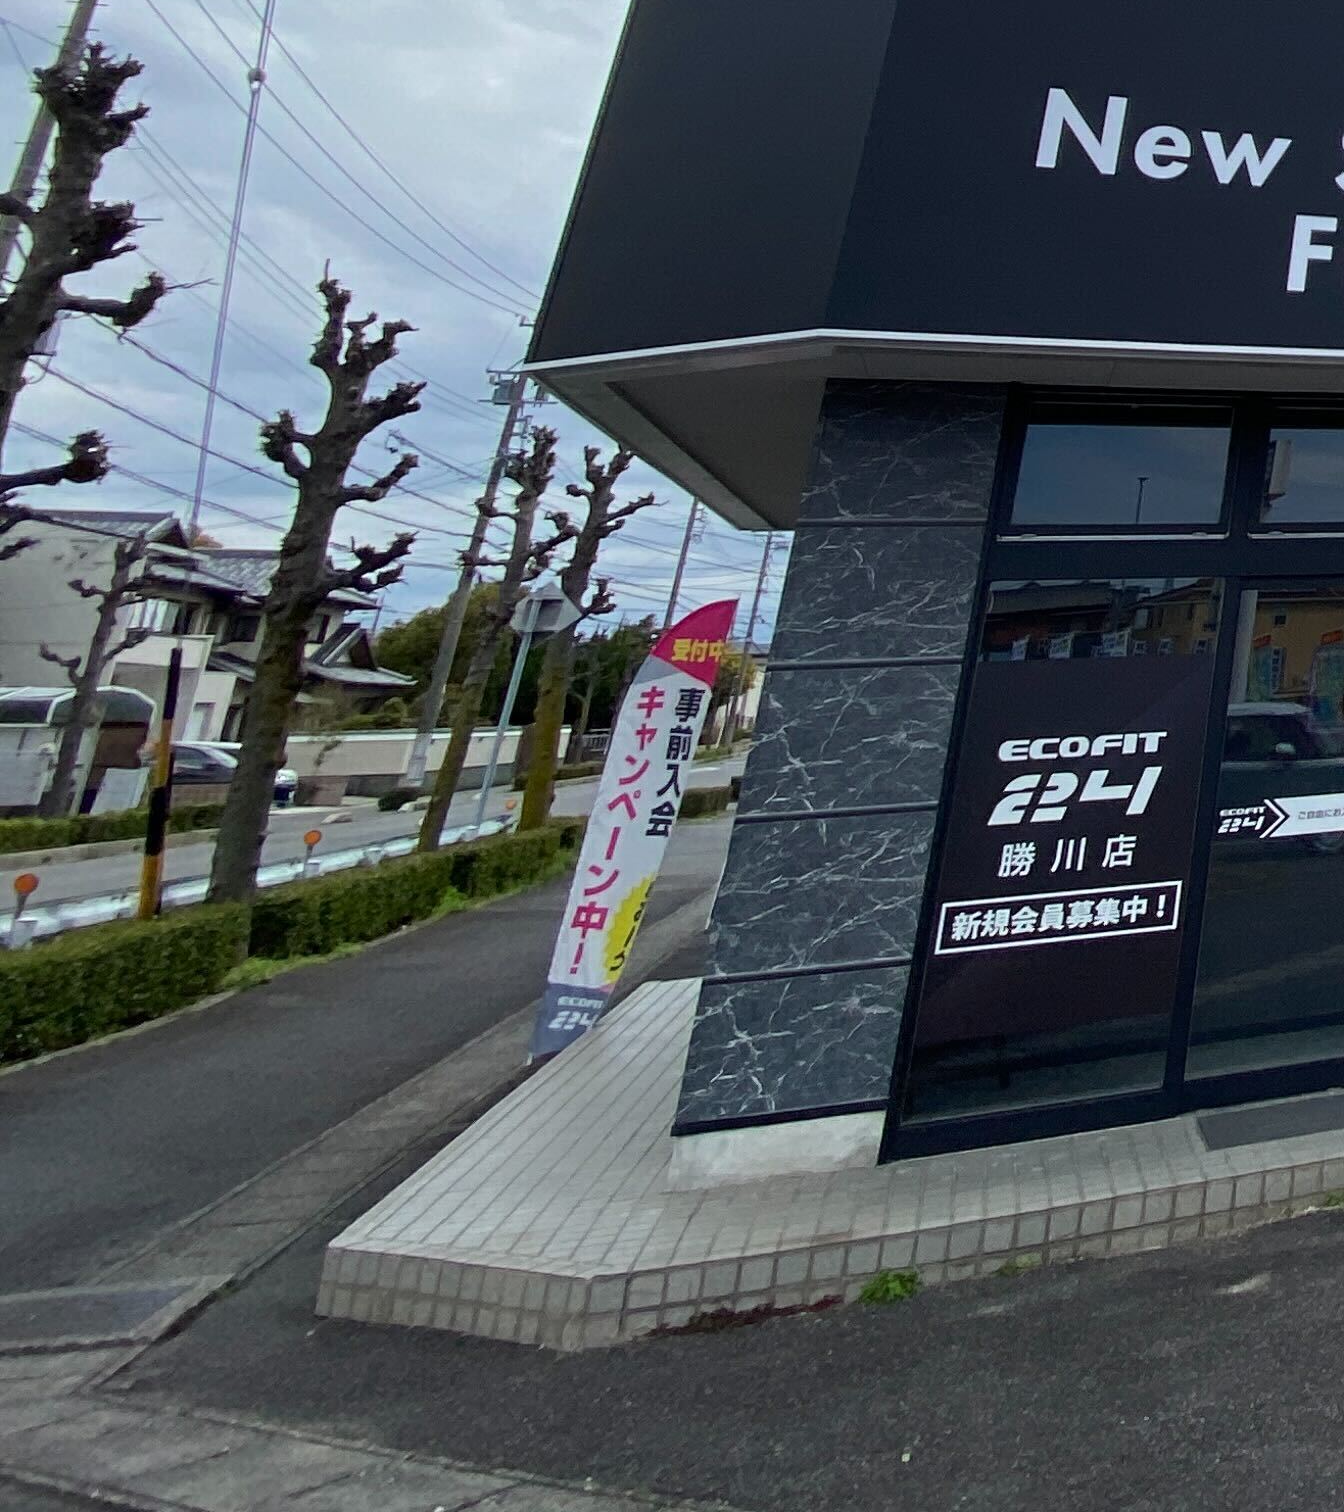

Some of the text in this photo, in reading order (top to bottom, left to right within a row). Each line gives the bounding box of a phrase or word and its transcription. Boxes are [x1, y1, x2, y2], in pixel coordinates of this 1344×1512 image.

[1035, 88, 1293, 187] New
[645, 687, 706, 839] 事前入会
[998, 732, 1168, 762] ECOFIT
[987, 766, 1163, 826] 24
